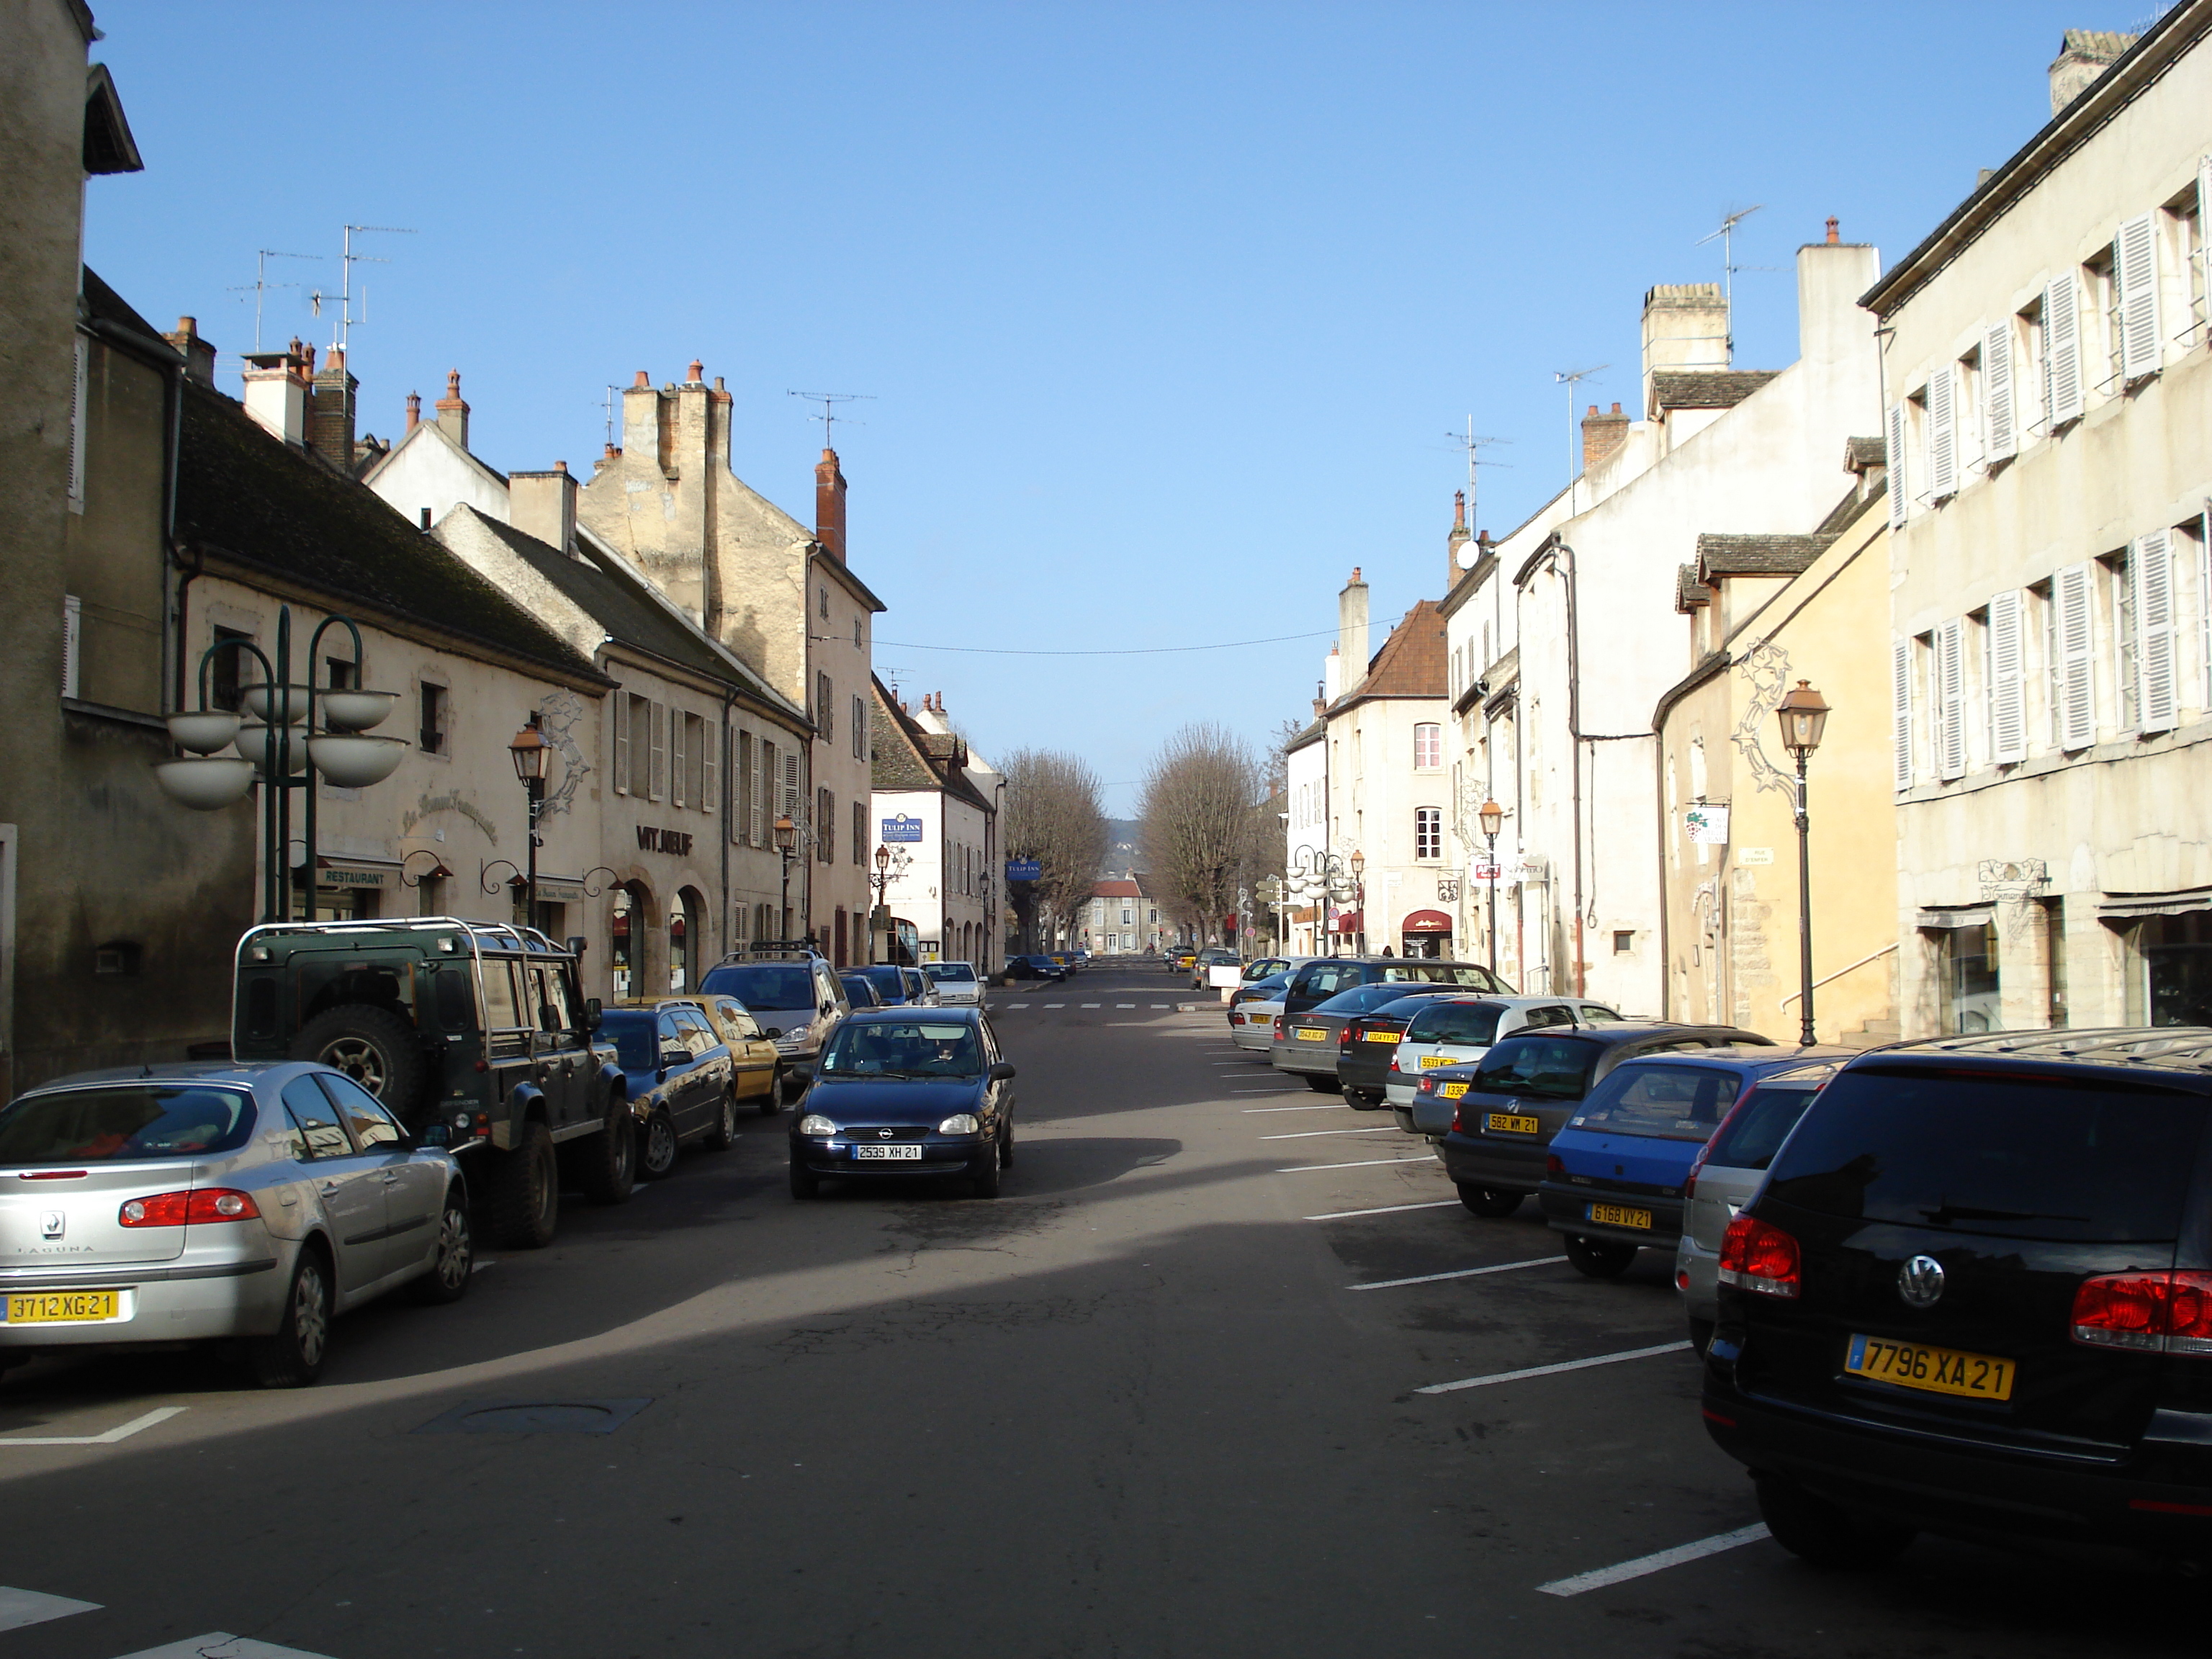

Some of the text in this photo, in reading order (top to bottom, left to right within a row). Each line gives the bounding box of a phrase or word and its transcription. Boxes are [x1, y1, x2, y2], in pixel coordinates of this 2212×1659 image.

[325, 871, 384, 884] RESTAURANT
[1422, 1058, 1438, 1067] 5533
[1447, 1085, 1465, 1096] 1336
[1492, 1116, 1507, 1128] 582
[1525, 1120, 1534, 1131] 21
[860, 1147, 917, 1158] 2539 XH 21
[1595, 1205, 1649, 1226] 6168 VY 21
[1867, 1342, 1930, 1380] 7796
[1934, 1352, 1965, 1387] XA
[1971, 1360, 2005, 1393] 21
